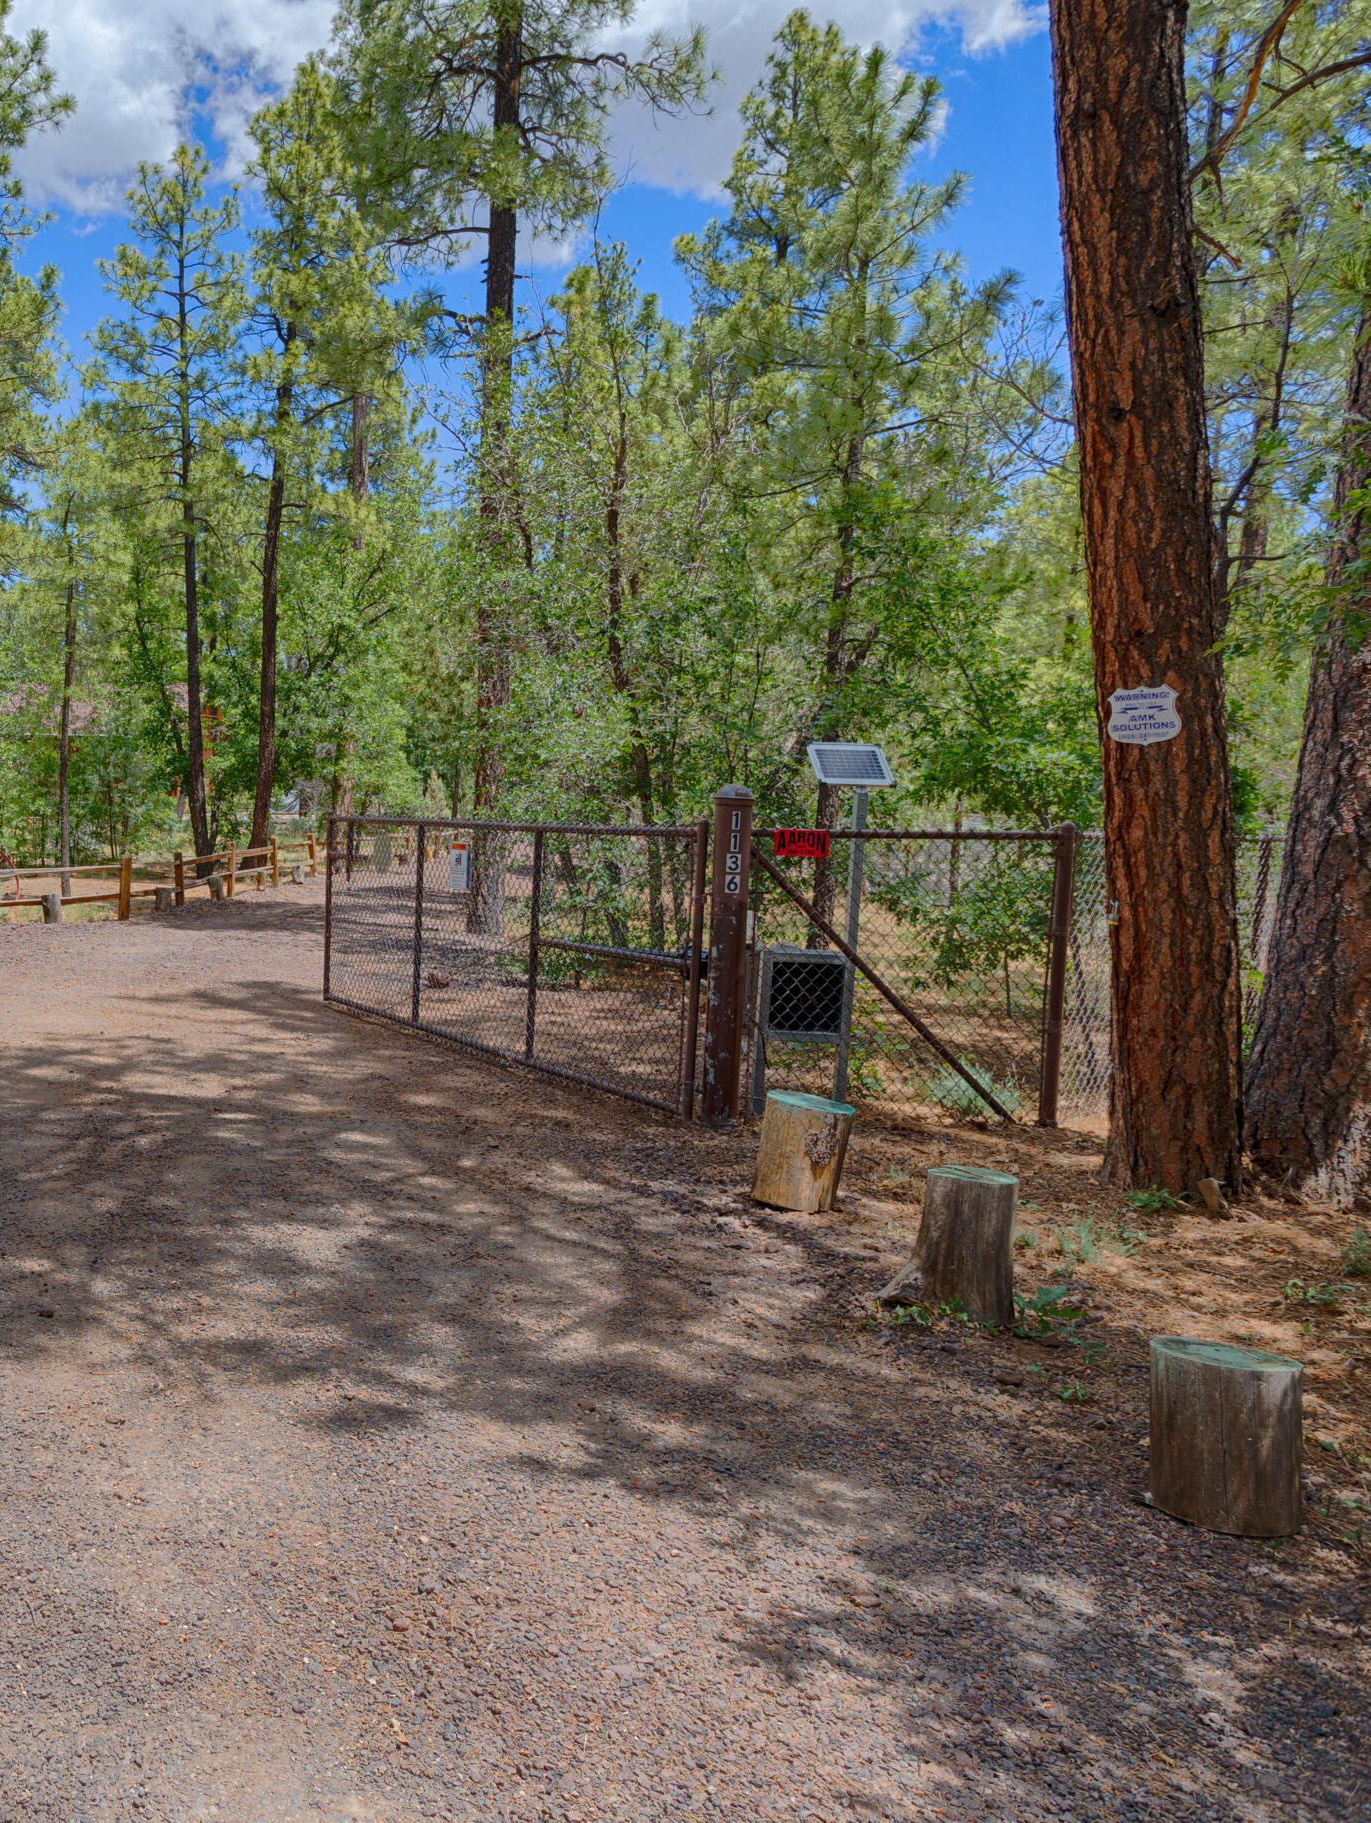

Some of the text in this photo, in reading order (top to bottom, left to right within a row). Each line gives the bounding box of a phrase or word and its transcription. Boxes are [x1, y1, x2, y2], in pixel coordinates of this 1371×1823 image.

[1128, 713, 1156, 722] AMK
[1111, 721, 1176, 732] SOLUTIONS
[777, 831, 826, 854] AARON
[726, 812, 741, 892] 1136
